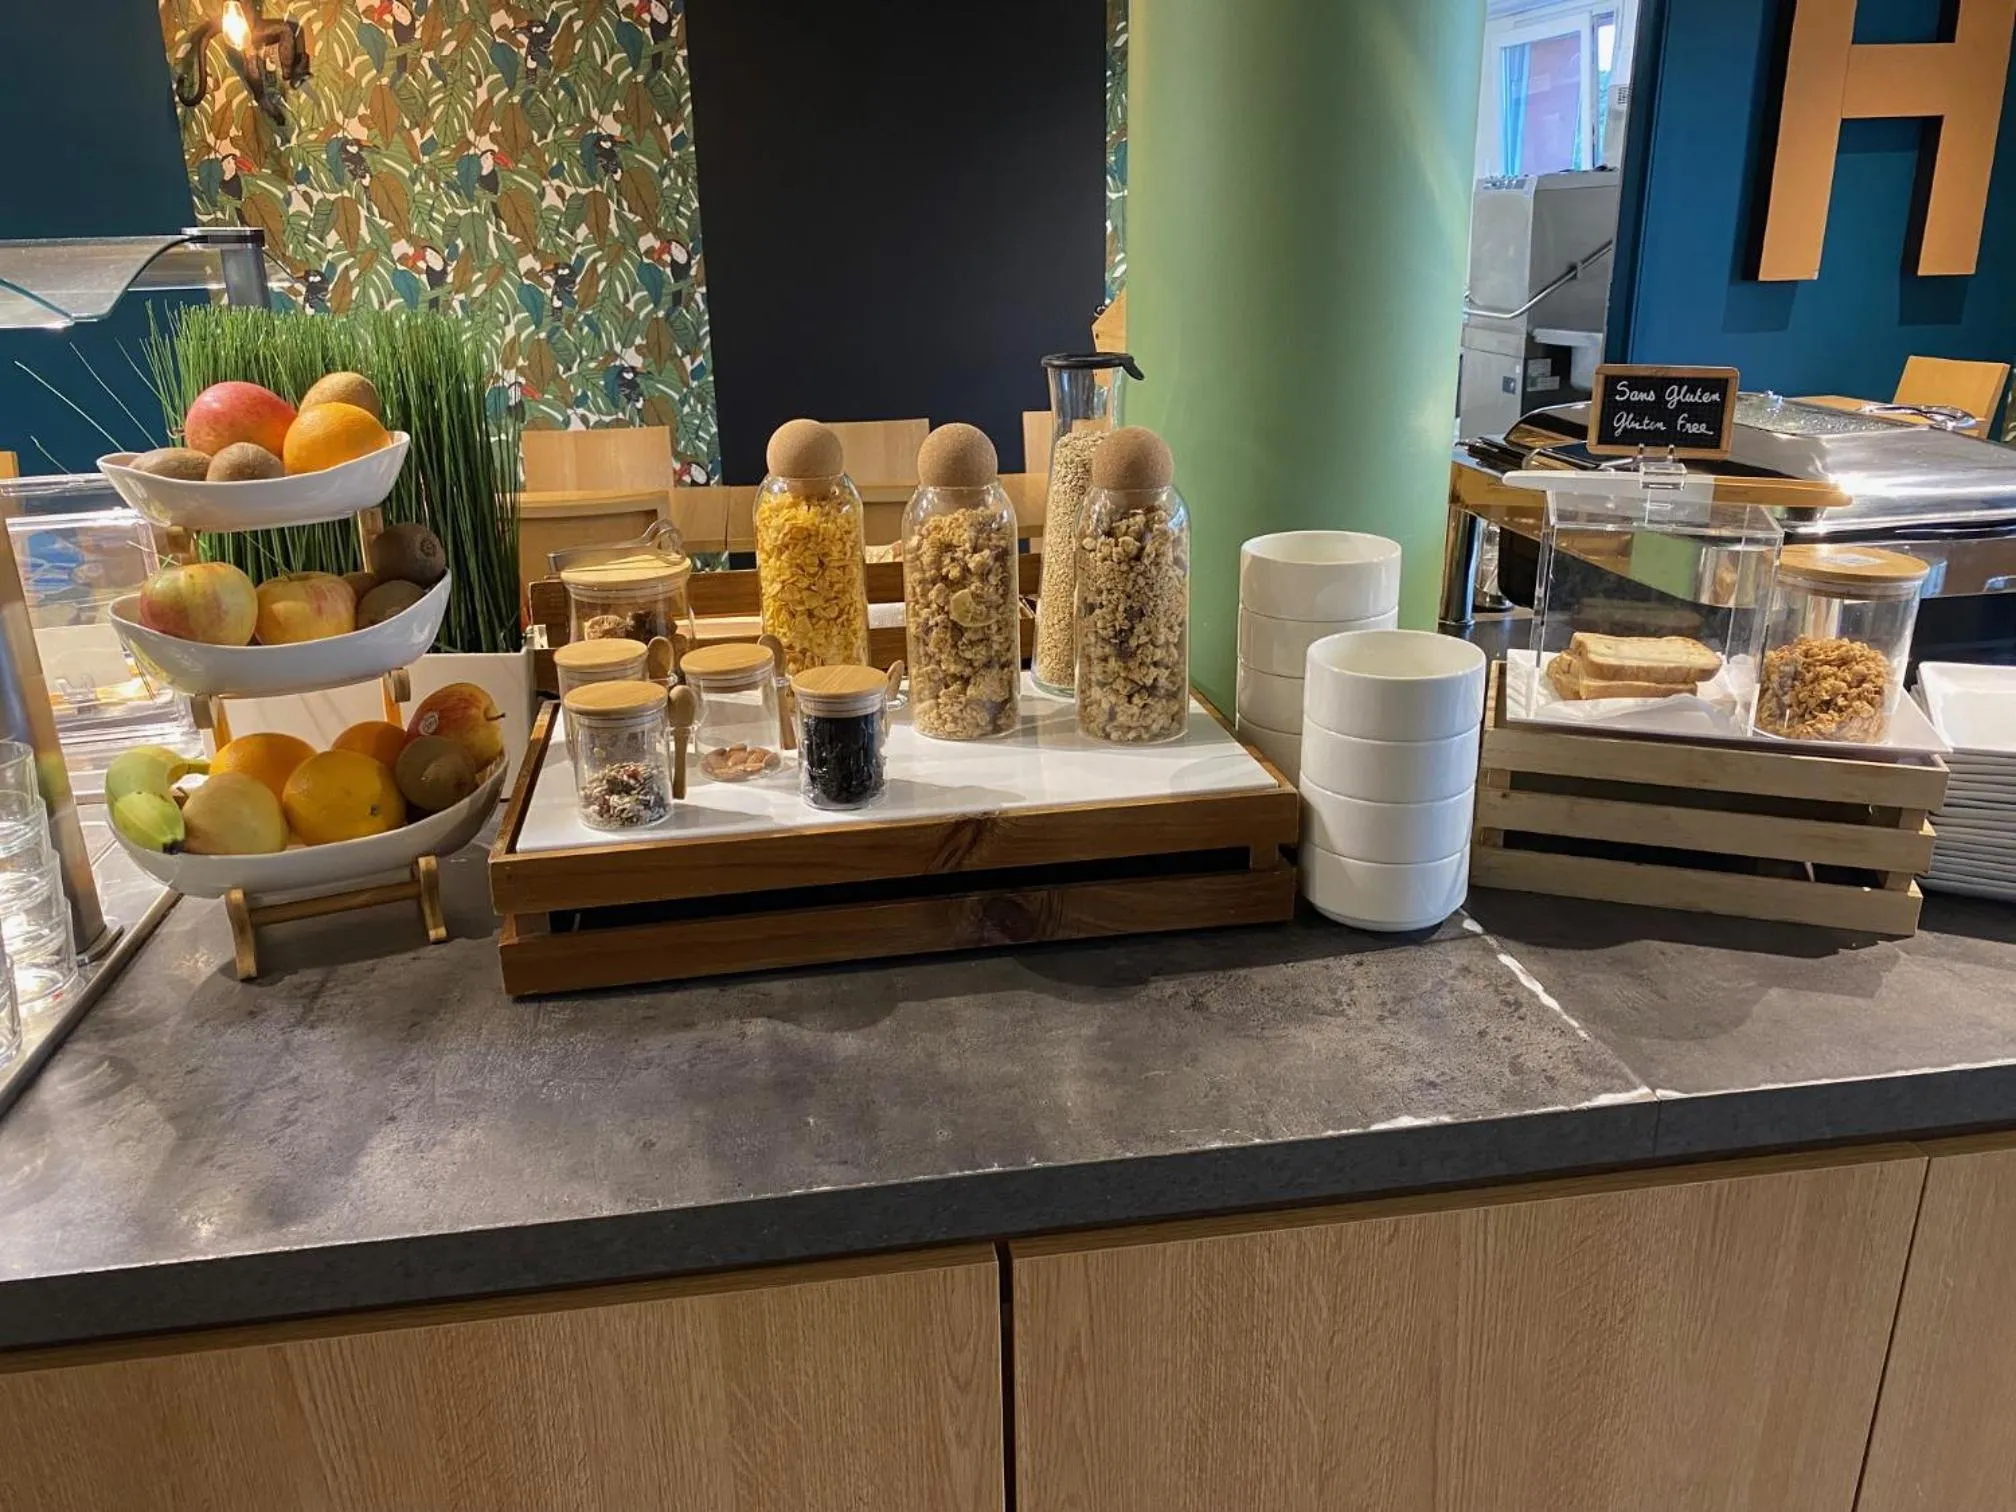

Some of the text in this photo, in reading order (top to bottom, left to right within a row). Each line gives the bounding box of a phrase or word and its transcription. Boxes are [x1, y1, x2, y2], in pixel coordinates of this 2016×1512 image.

[1758, 0, 2016, 281] H
[1614, 380, 1721, 410] Sans Gluten
[1612, 410, 1715, 437] Gluten Free
